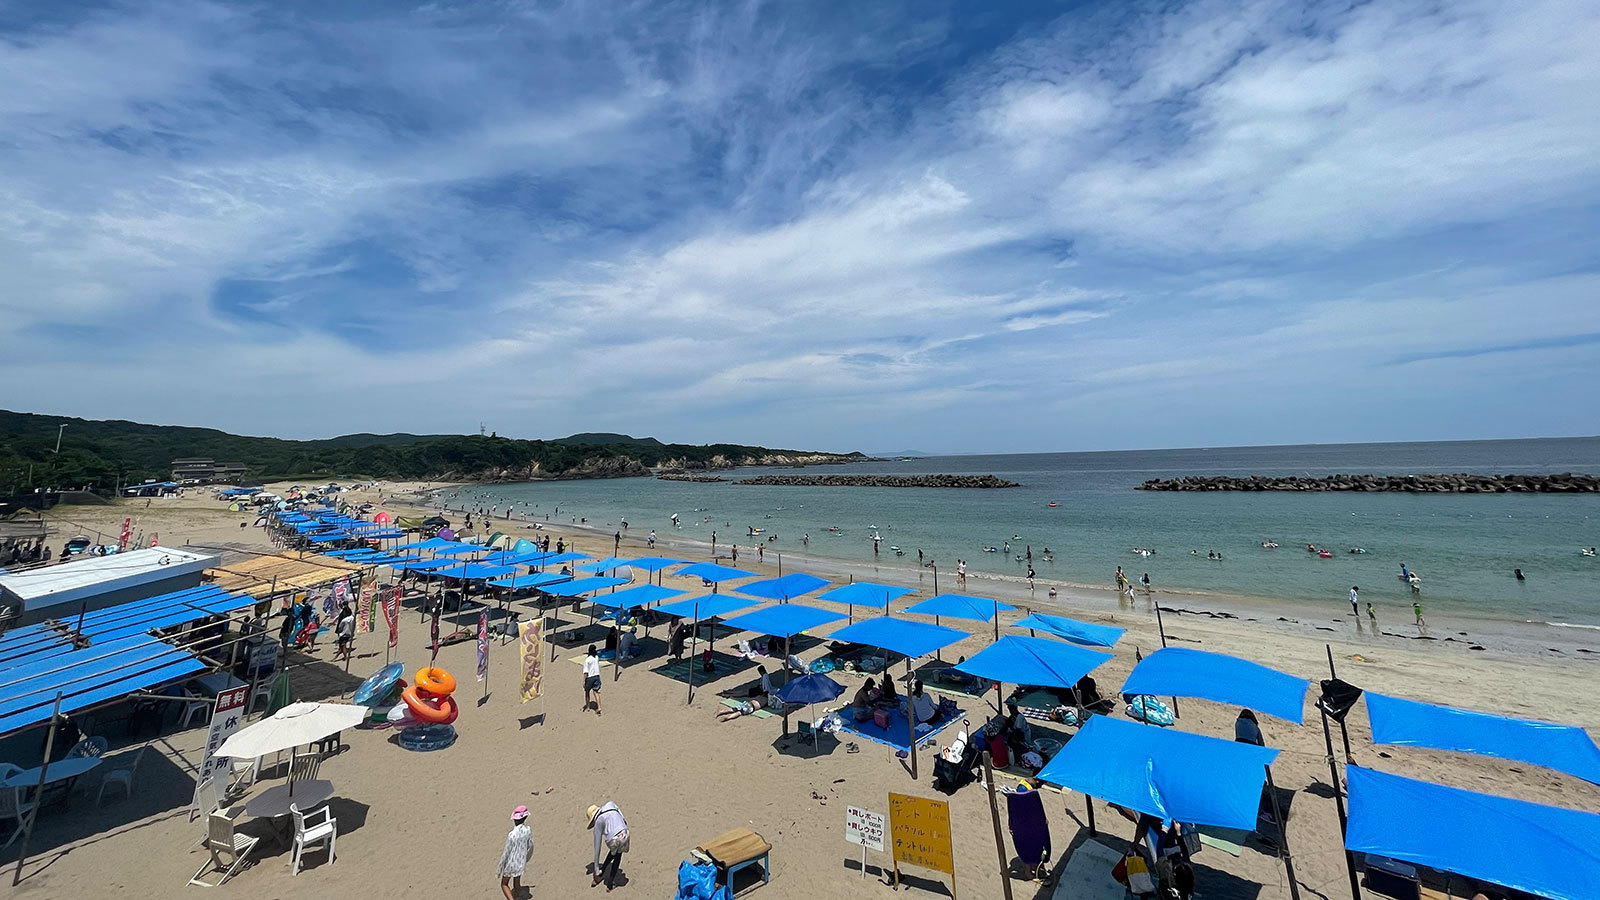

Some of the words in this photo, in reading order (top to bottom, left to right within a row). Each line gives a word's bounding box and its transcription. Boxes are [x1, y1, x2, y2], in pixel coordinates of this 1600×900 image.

[218, 690, 246, 709] 無料
[215, 715, 239, 770] 休所
[851, 822, 883, 837] 貸しウキワ
